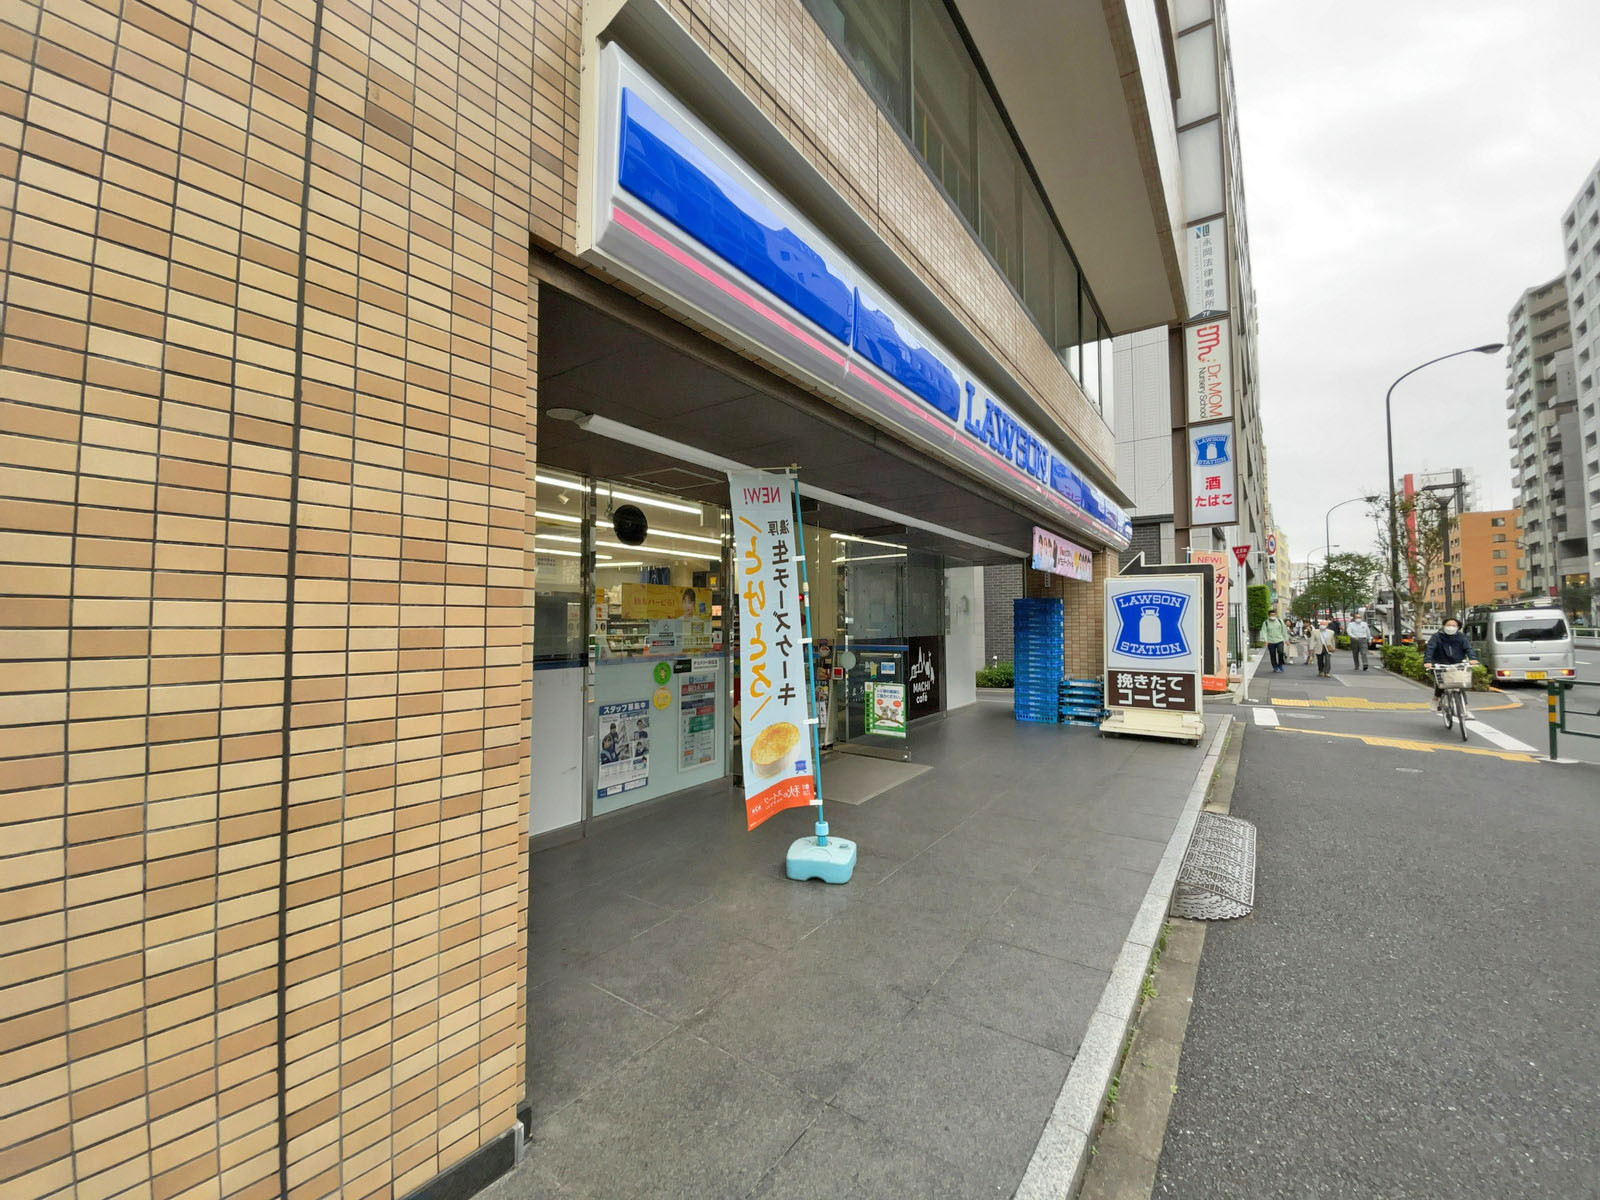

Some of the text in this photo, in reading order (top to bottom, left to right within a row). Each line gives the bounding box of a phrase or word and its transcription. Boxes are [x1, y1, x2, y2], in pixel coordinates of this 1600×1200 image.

[1198, 366, 1208, 419] Nursery School
[1207, 364, 1224, 418] Dr. MOM
[964, 380, 1049, 484] LAWSON
[1196, 435, 1227, 445] LAWSON
[1197, 457, 1228, 466] STATION
[1205, 475, 1222, 490] 酒
[1195, 493, 1233, 508] たばこ
[1197, 556, 1223, 564] NEW!
[1119, 594, 1183, 608] LAWSON
[1120, 641, 1182, 655] STATION
[913, 681, 931, 693] MACHI
[1116, 673, 1184, 690] 挽きたて
[1118, 689, 1185, 708] コーヒー
